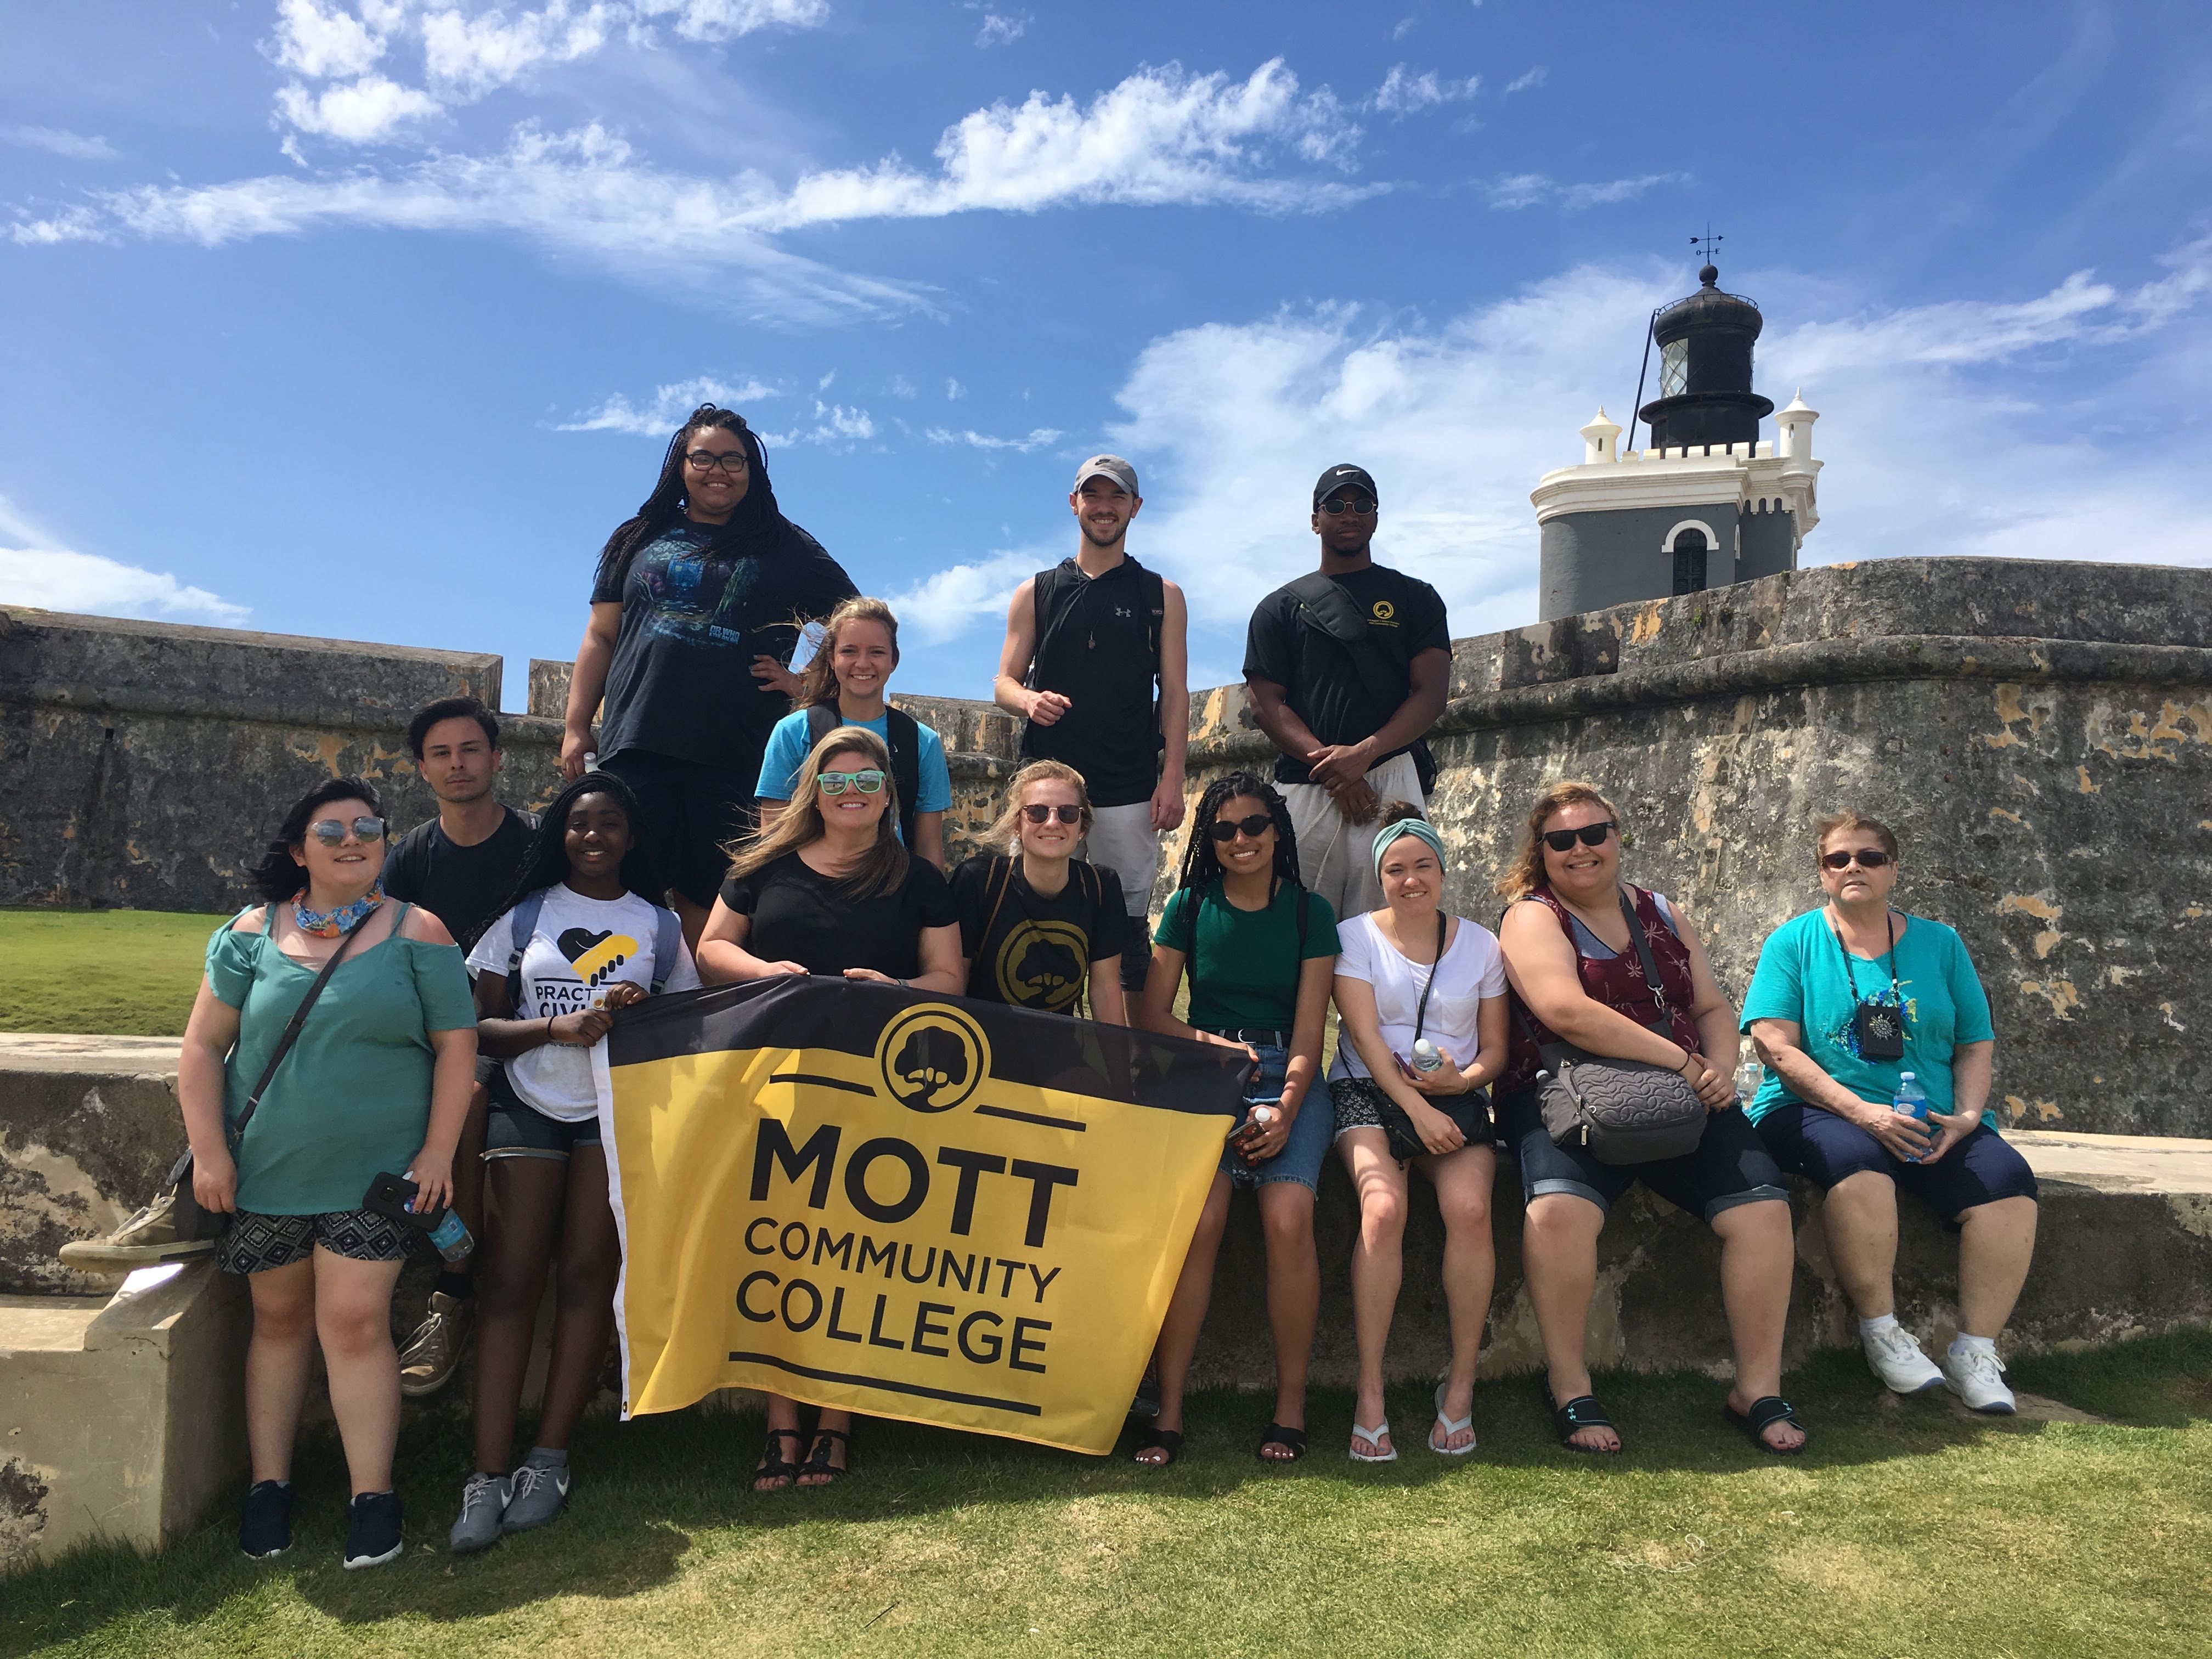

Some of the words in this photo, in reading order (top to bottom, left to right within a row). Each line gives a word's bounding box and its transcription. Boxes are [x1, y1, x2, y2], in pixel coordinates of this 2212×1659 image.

[723, 627, 740, 639] WHO
[535, 986, 601, 1001] PRACT
[749, 1118, 1079, 1248] MOTT
[744, 1217, 1062, 1304] COMMUNITY
[736, 1270, 1052, 1374] COLLEGE
